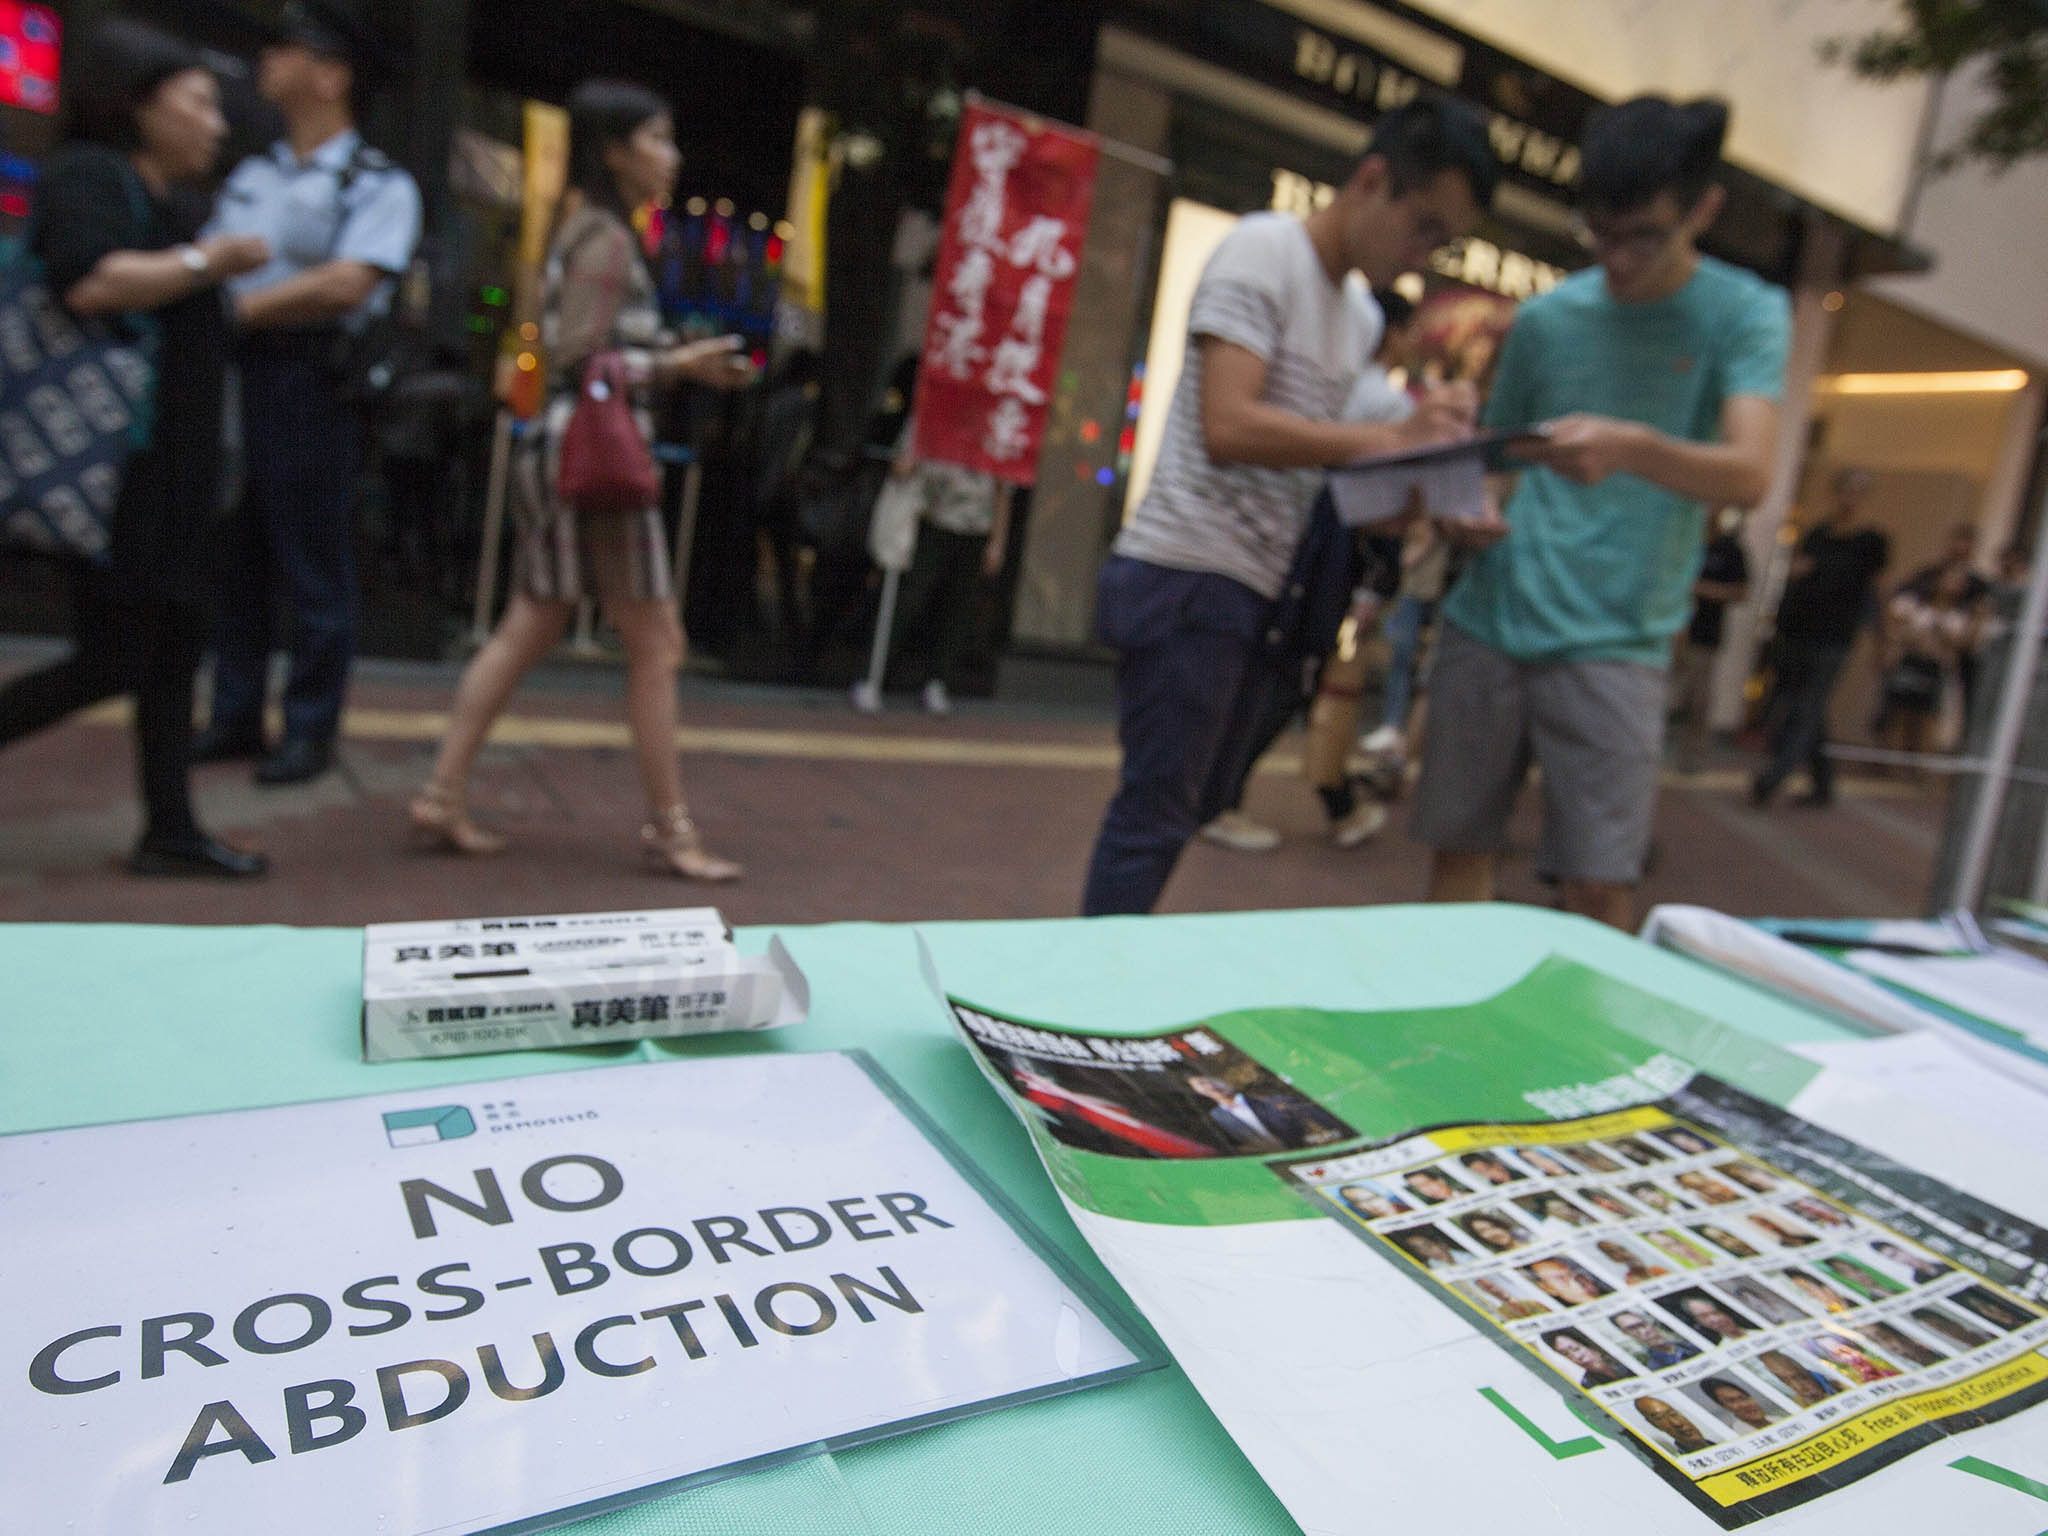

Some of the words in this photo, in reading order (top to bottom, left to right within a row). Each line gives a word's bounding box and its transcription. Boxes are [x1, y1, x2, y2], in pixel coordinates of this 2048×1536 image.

[571, 994, 670, 1029] 真美筆
[400, 1154, 624, 1240] NO
[28, 1192, 955, 1396] CROSS-BORDER
[162, 1265, 925, 1485] ABDUCTION
[1862, 1414, 1899, 1434] Free
